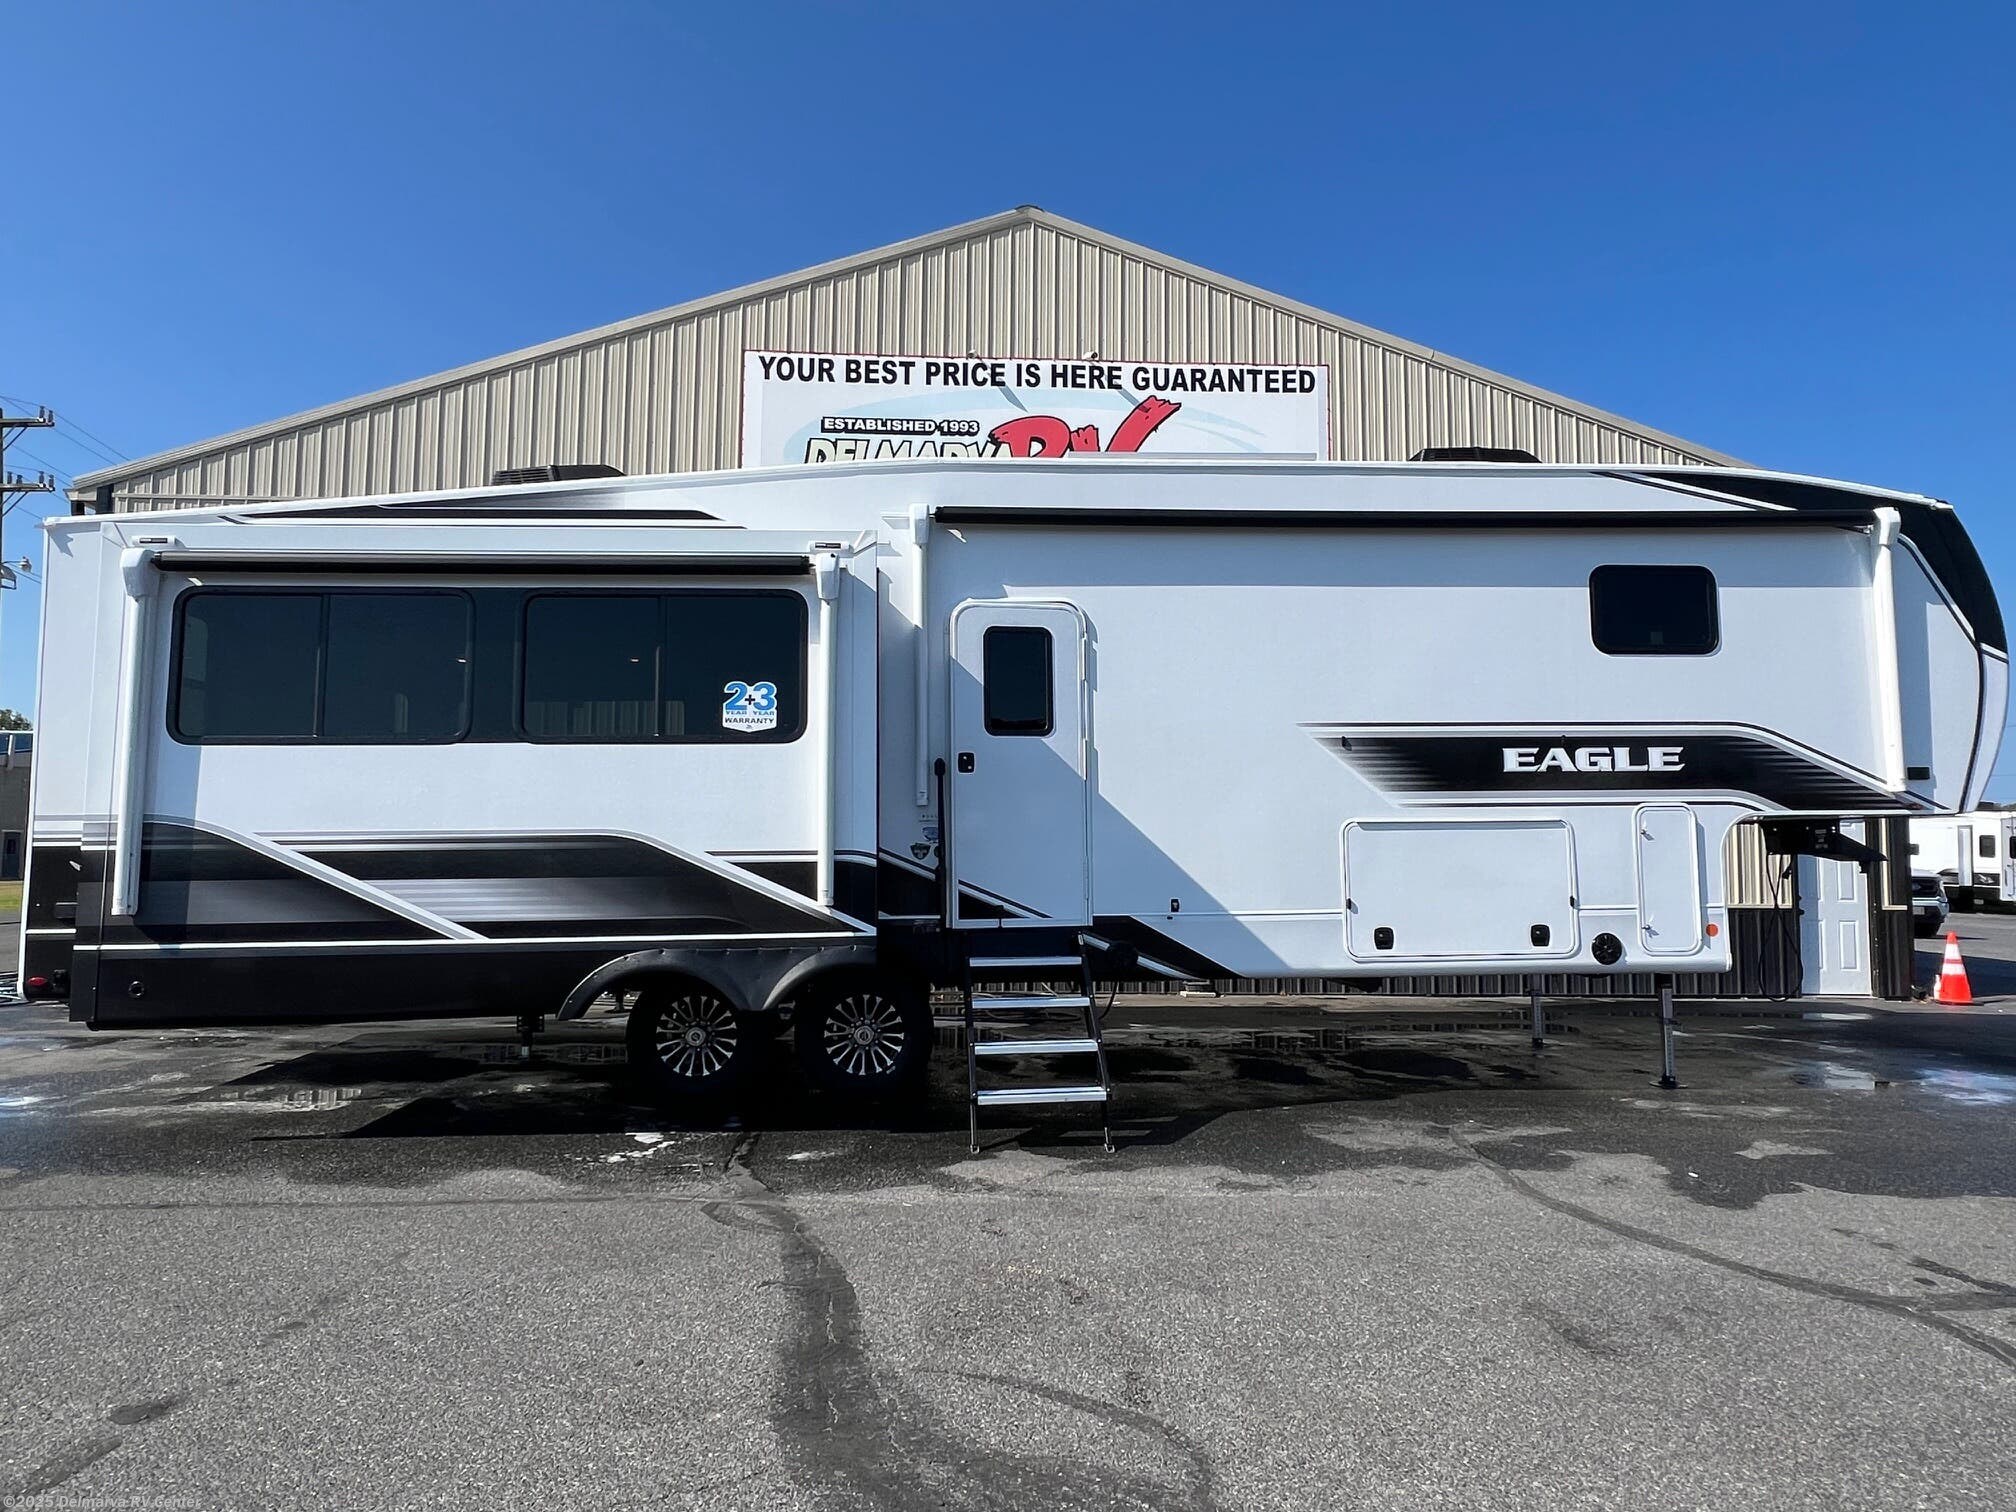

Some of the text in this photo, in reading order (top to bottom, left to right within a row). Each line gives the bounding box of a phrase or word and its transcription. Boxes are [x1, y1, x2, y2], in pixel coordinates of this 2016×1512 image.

[759, 356, 1316, 393] YOUR BEST PRICE IS HERE GUARANTEED
[823, 417, 979, 433] ESTABLISHED 1993
[1502, 746, 1686, 773] EAGLE
